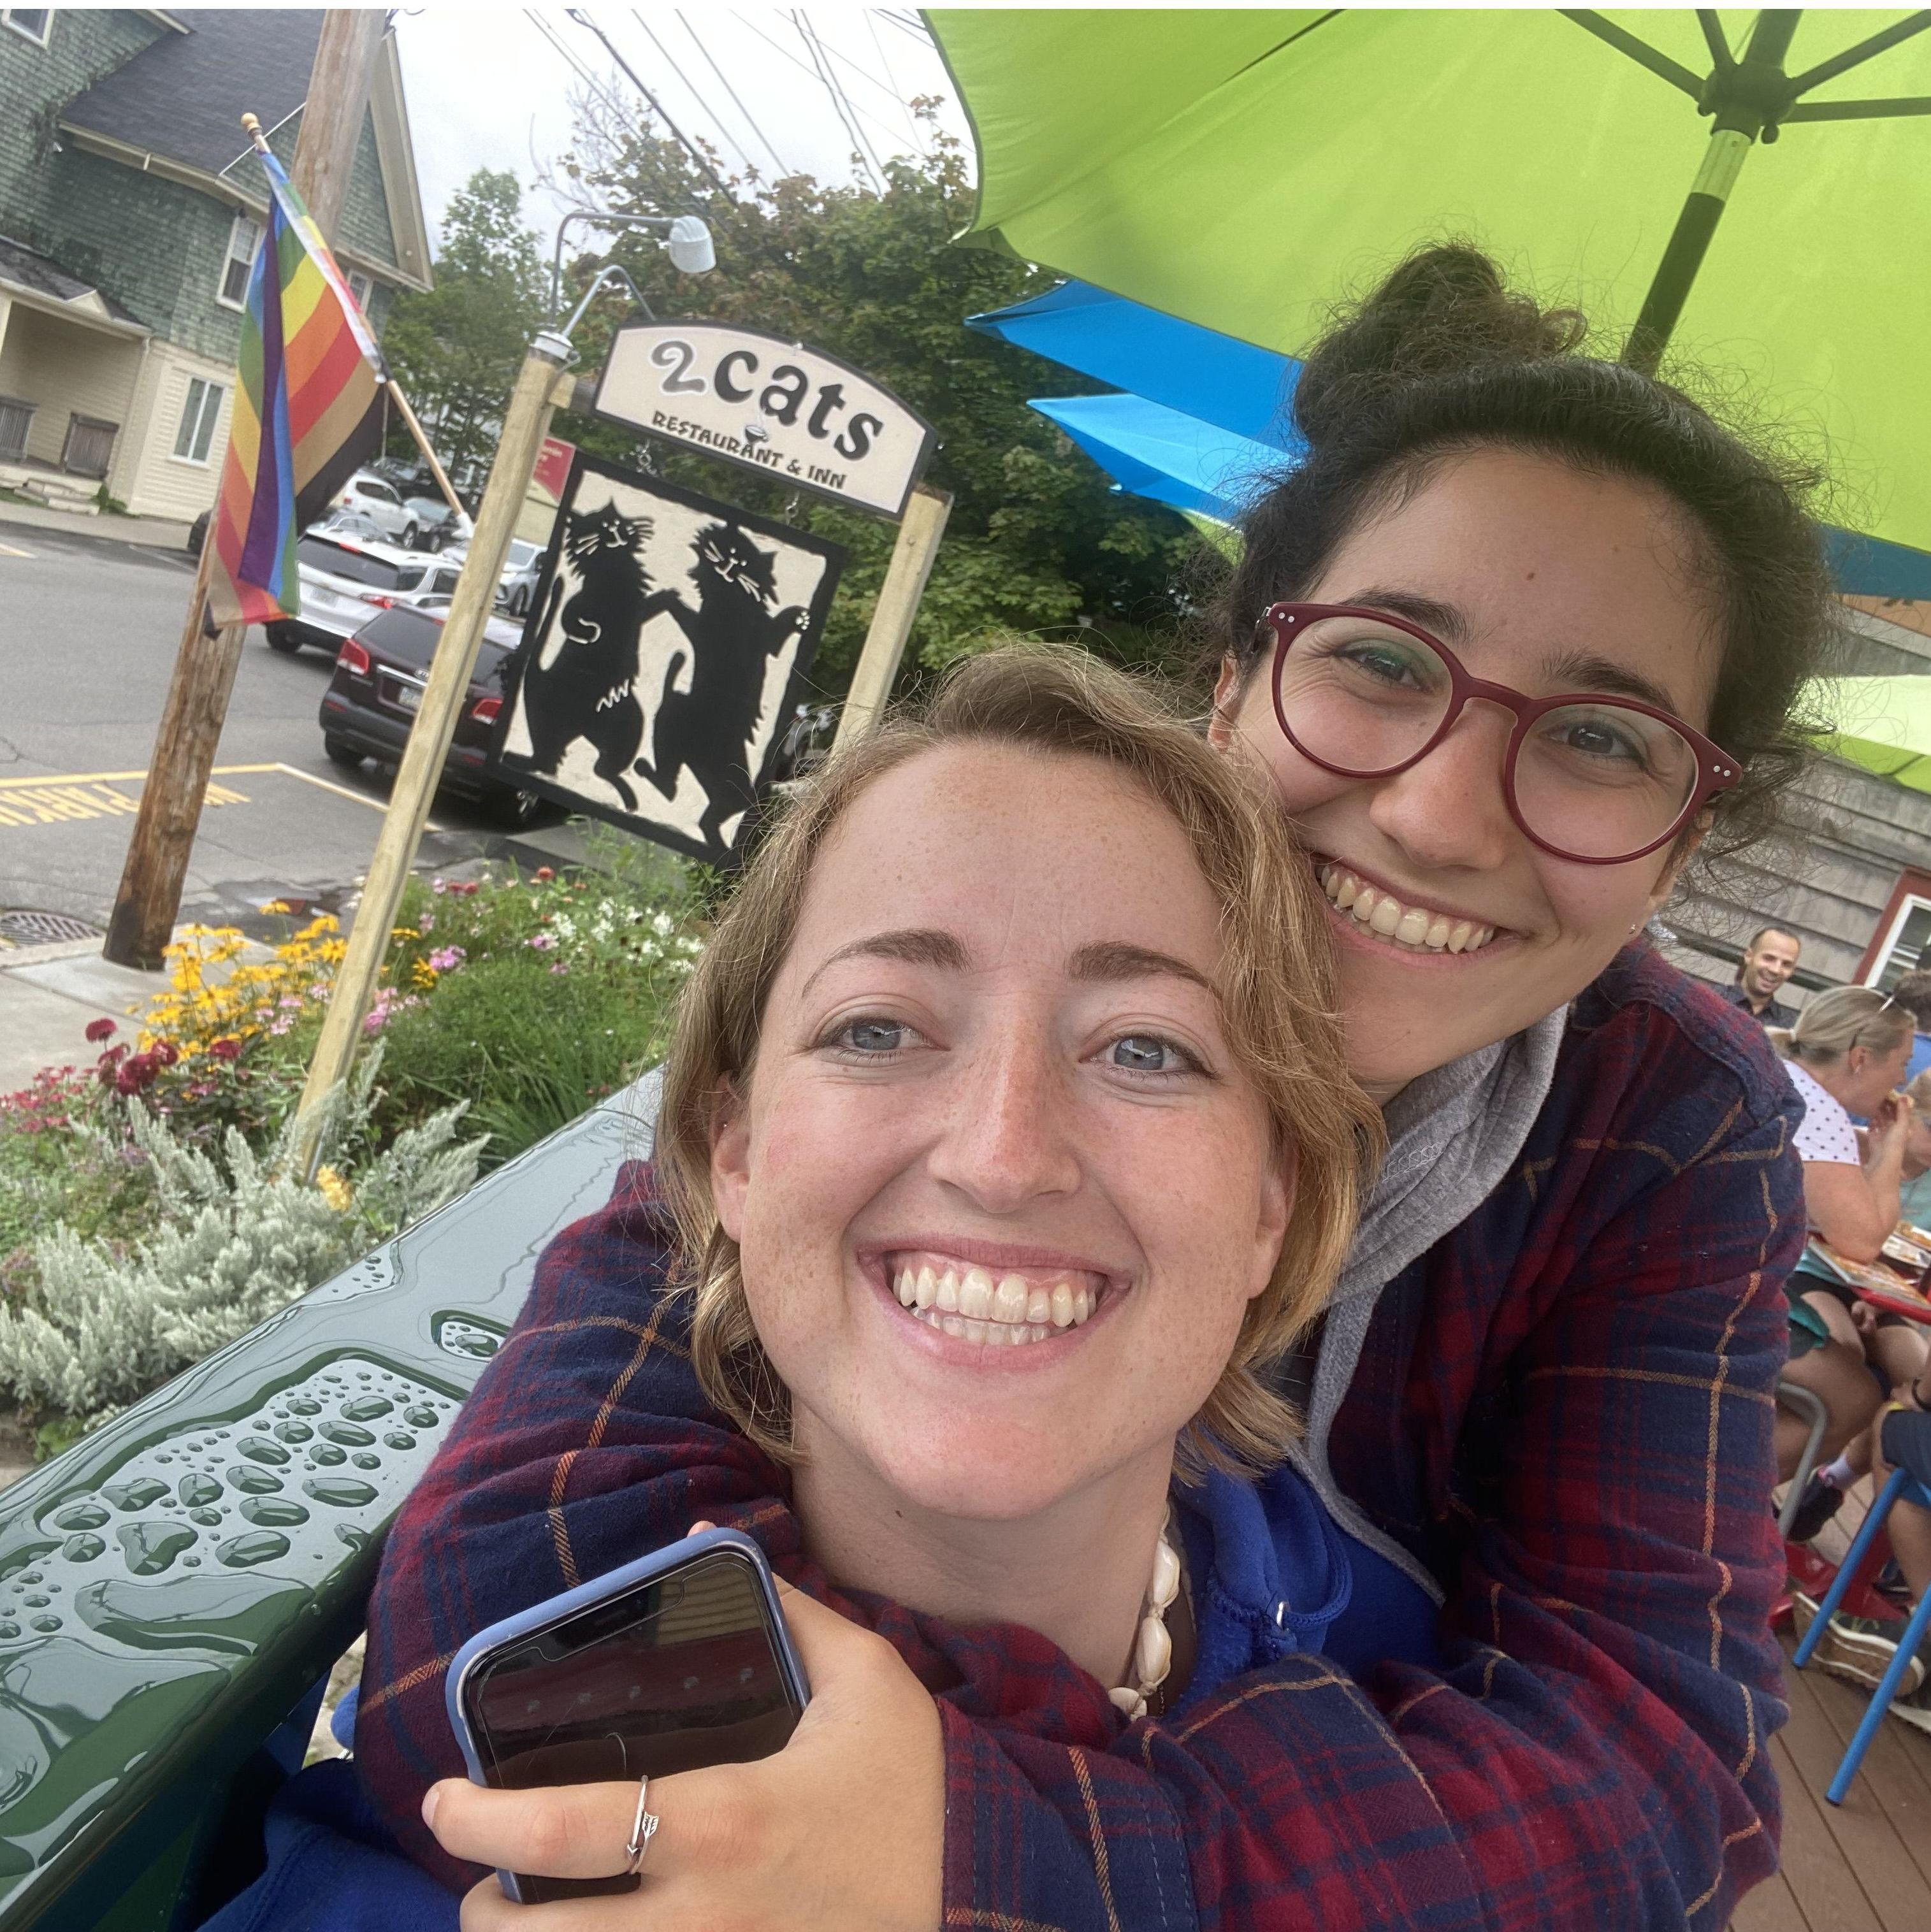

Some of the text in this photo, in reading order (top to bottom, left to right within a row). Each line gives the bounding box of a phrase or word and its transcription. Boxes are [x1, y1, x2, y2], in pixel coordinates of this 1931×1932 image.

[651, 341, 705, 394] 2
[653, 410, 847, 489] RESTAURANT & INN
